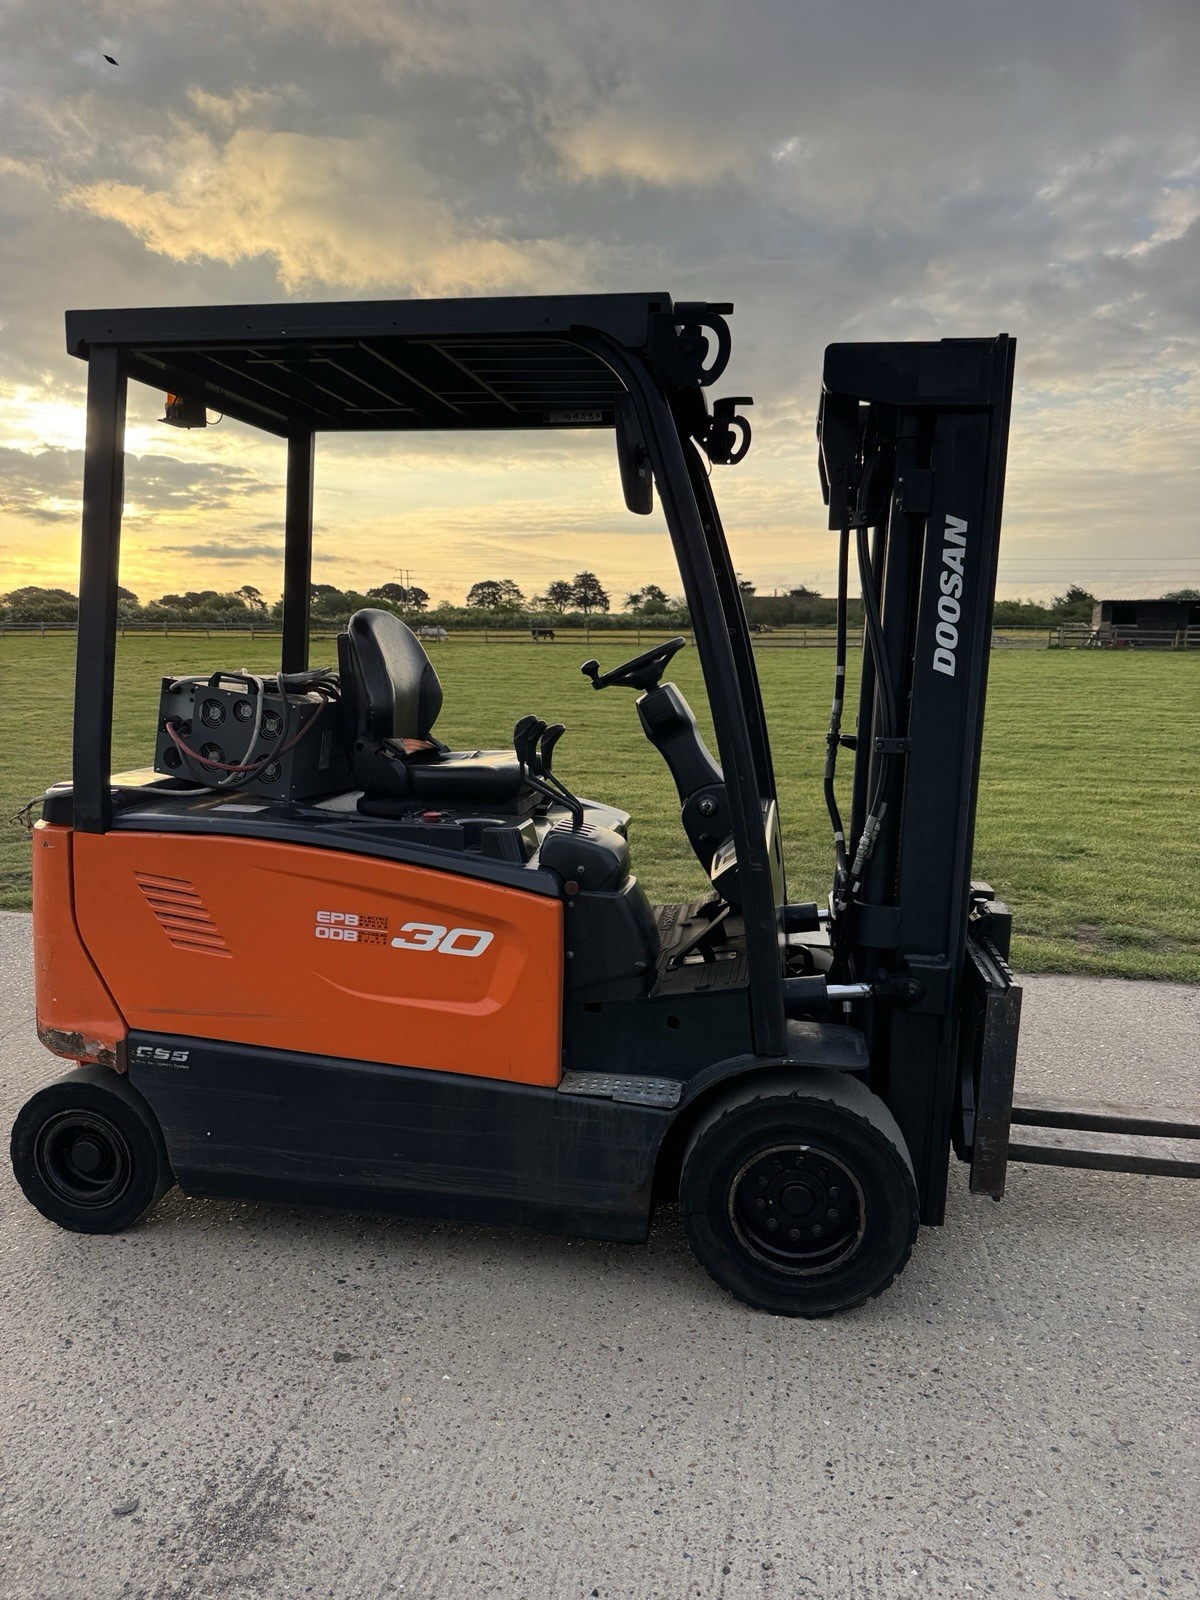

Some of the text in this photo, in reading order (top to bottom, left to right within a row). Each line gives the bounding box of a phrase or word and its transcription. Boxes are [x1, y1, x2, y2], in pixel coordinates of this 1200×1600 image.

[933, 514, 968, 677] DOOSAN
[316, 911, 359, 926] EPB
[315, 926, 358, 942] ODB
[391, 922, 494, 957] 30
